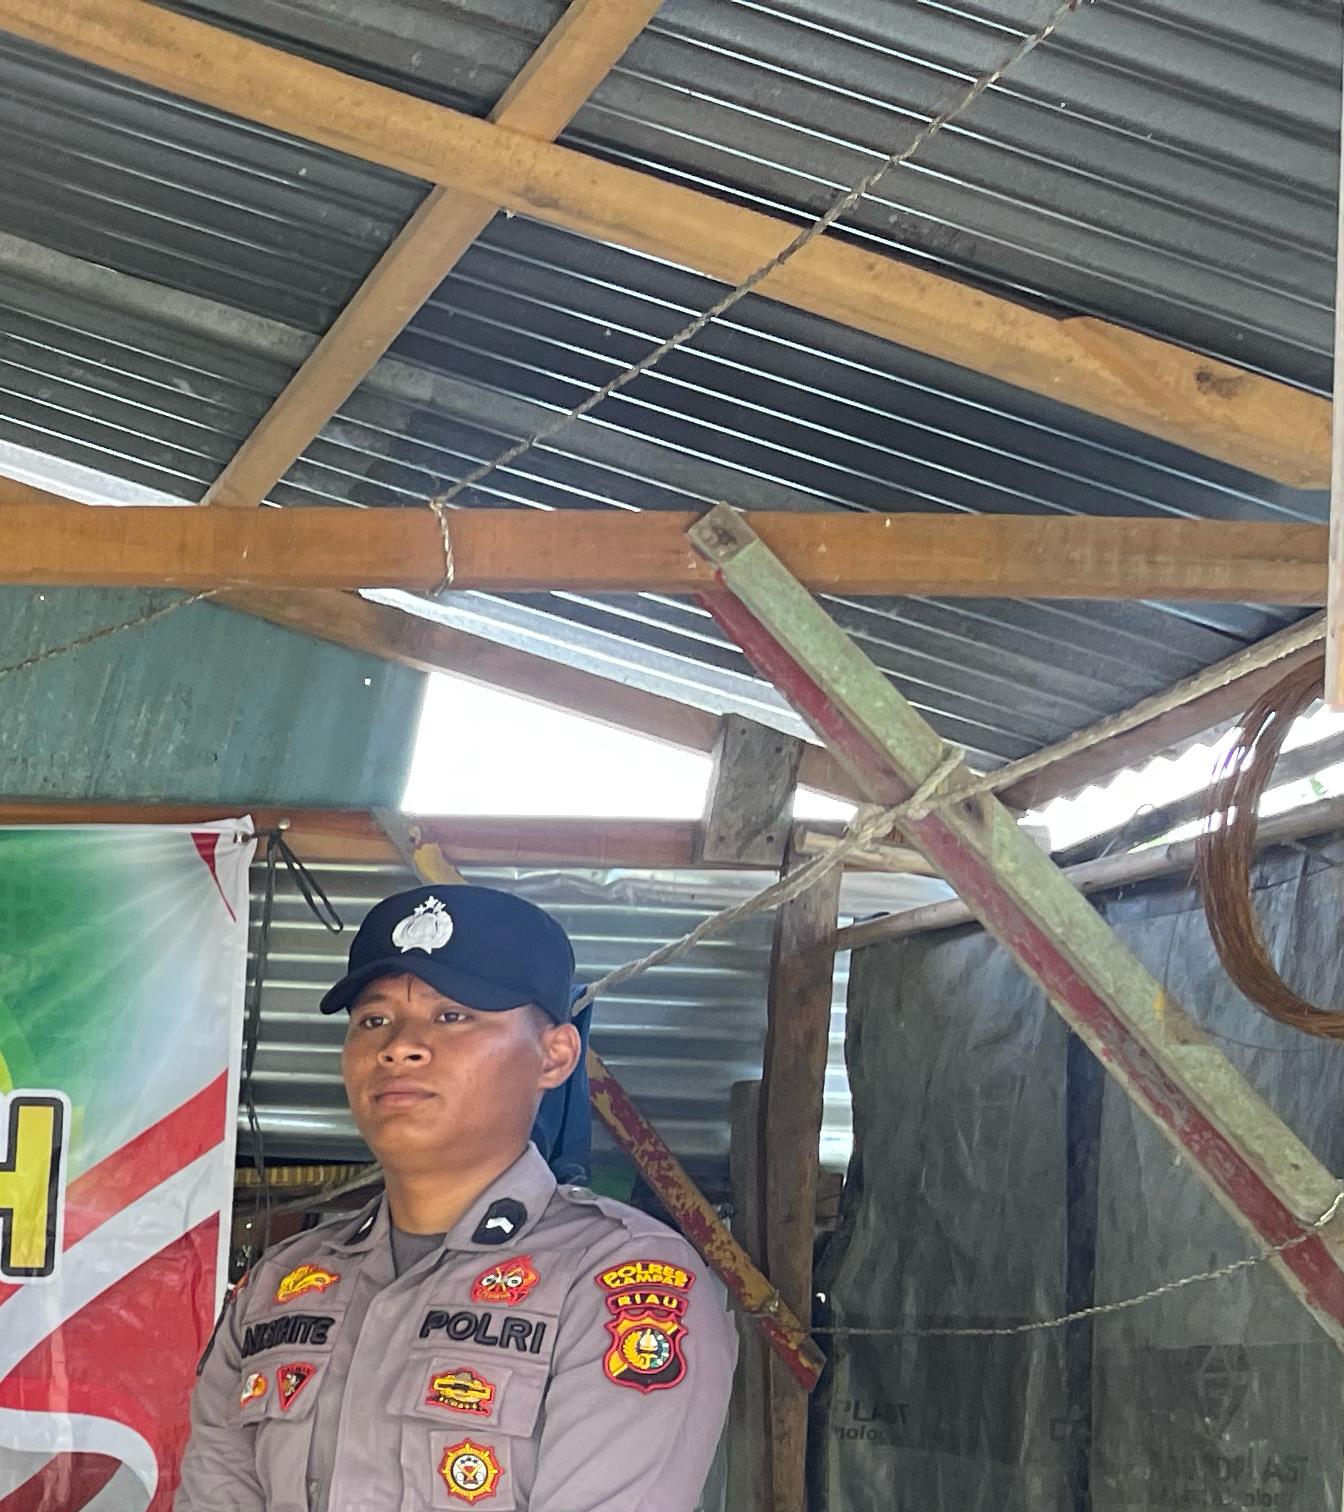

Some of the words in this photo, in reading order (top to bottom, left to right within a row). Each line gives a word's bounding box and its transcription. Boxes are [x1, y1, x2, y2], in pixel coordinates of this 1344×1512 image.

[602, 1262, 689, 1284] POLRES
[617, 1293, 678, 1309] RIAU
[419, 1310, 547, 1356] POLRI
